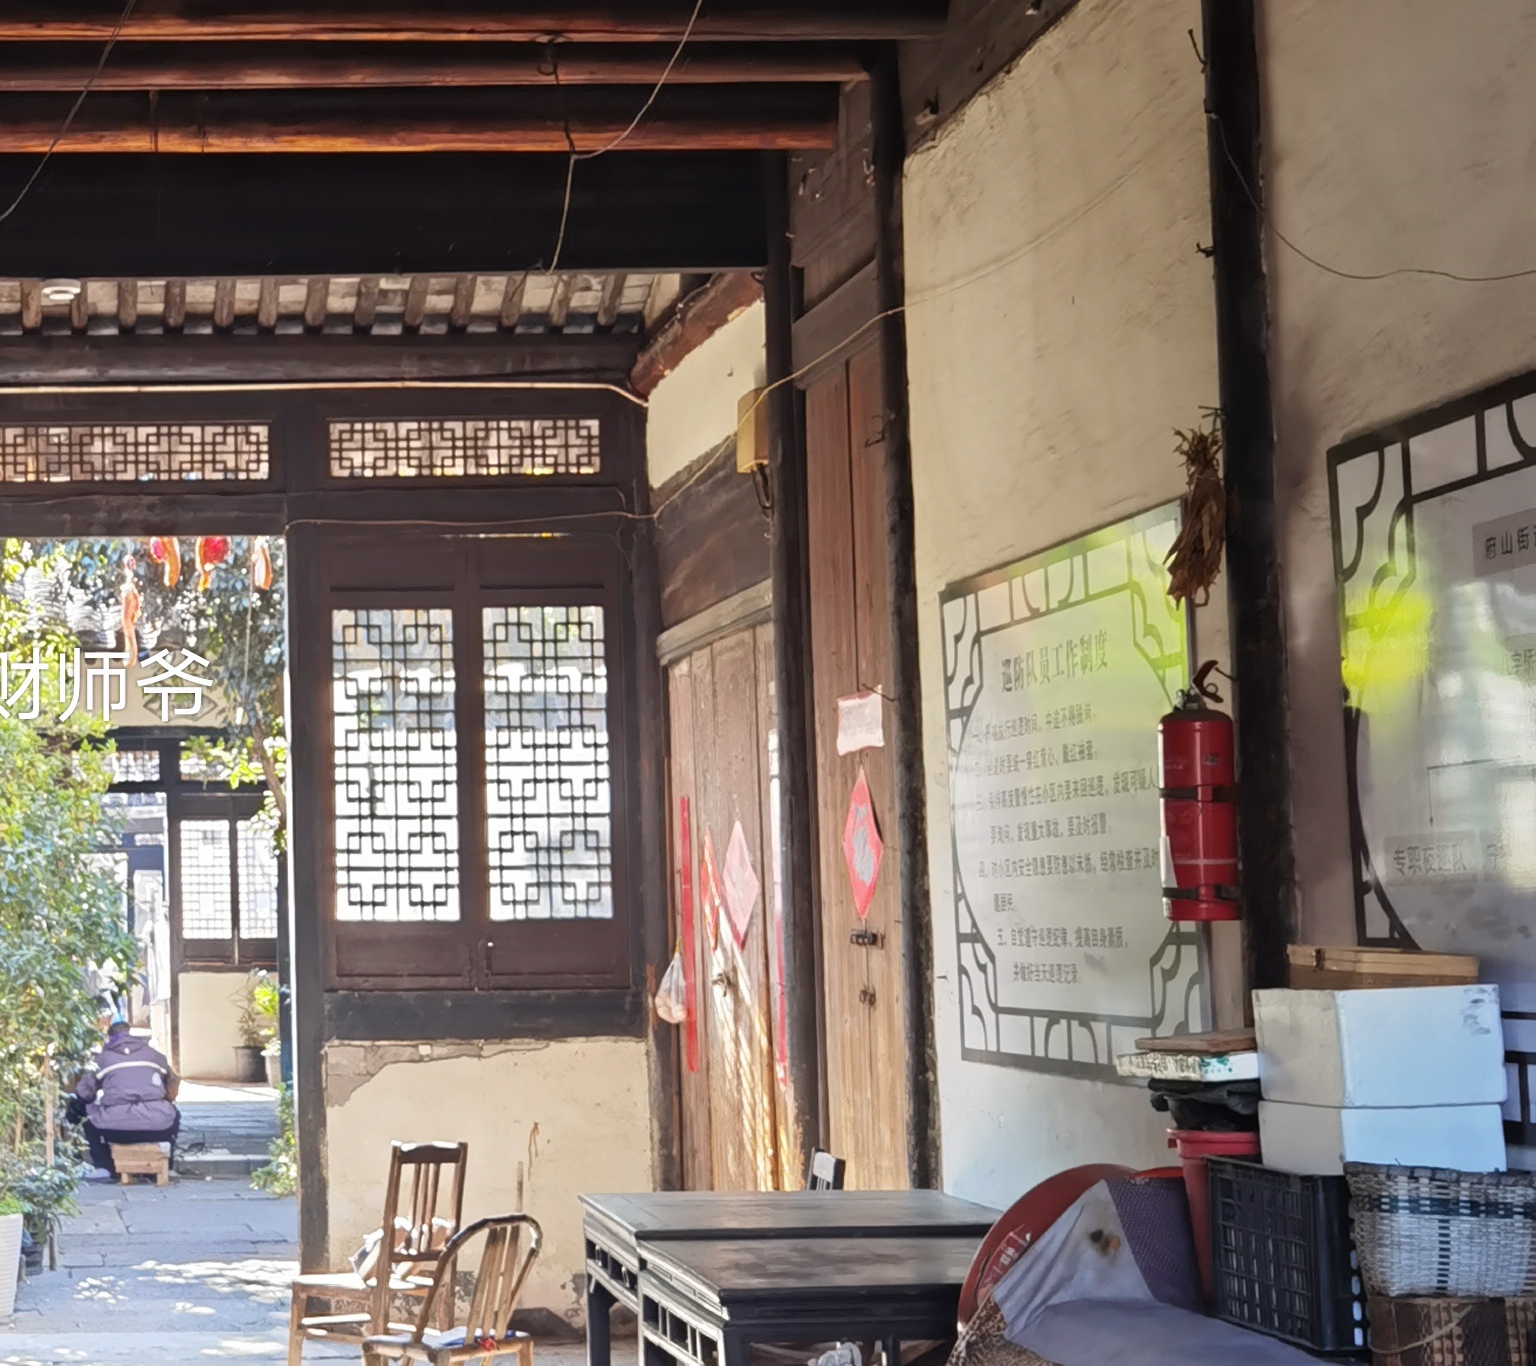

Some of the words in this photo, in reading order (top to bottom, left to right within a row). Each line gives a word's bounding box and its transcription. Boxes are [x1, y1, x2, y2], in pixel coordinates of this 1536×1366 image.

[1485, 524, 1536, 560] 府山街
[1001, 629, 1108, 693] 巡防队员工作制度
